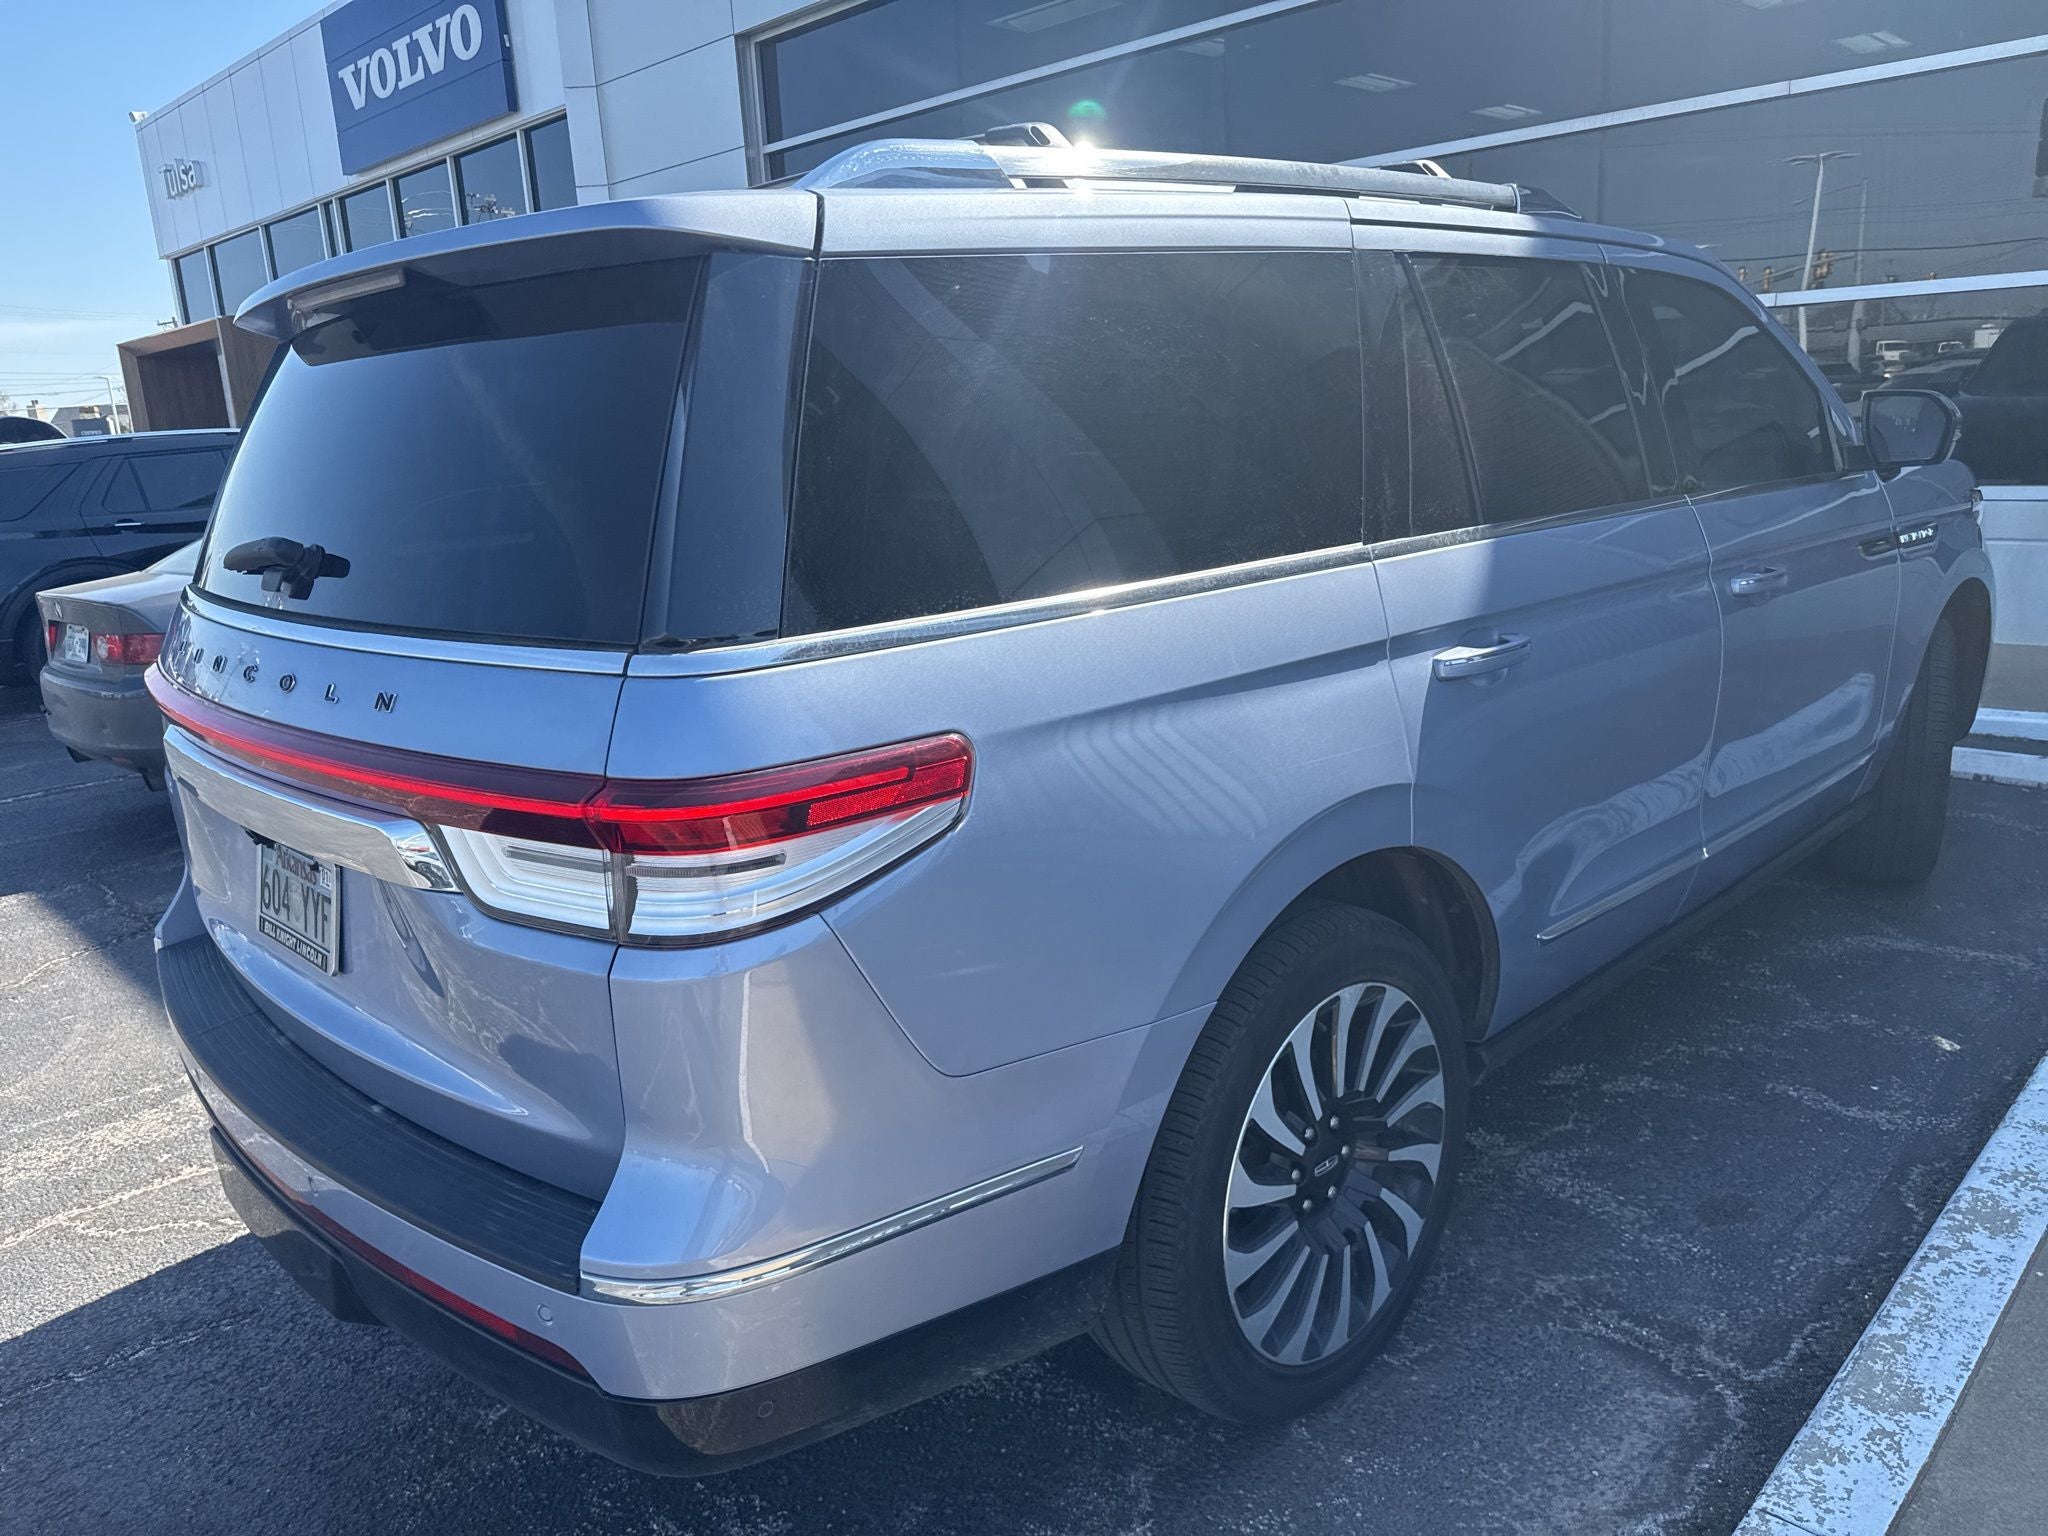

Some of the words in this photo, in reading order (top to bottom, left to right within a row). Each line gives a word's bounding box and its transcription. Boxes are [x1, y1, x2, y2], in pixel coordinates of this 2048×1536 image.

[337, 4, 482, 111] VOLVO
[158, 159, 202, 200] Tulsa
[178, 640, 397, 713] LINCOLN
[261, 863, 290, 922] 604
[301, 882, 331, 943] YYF
[264, 921, 276, 938] BILL
[296, 939, 323, 967] LINCOLN
